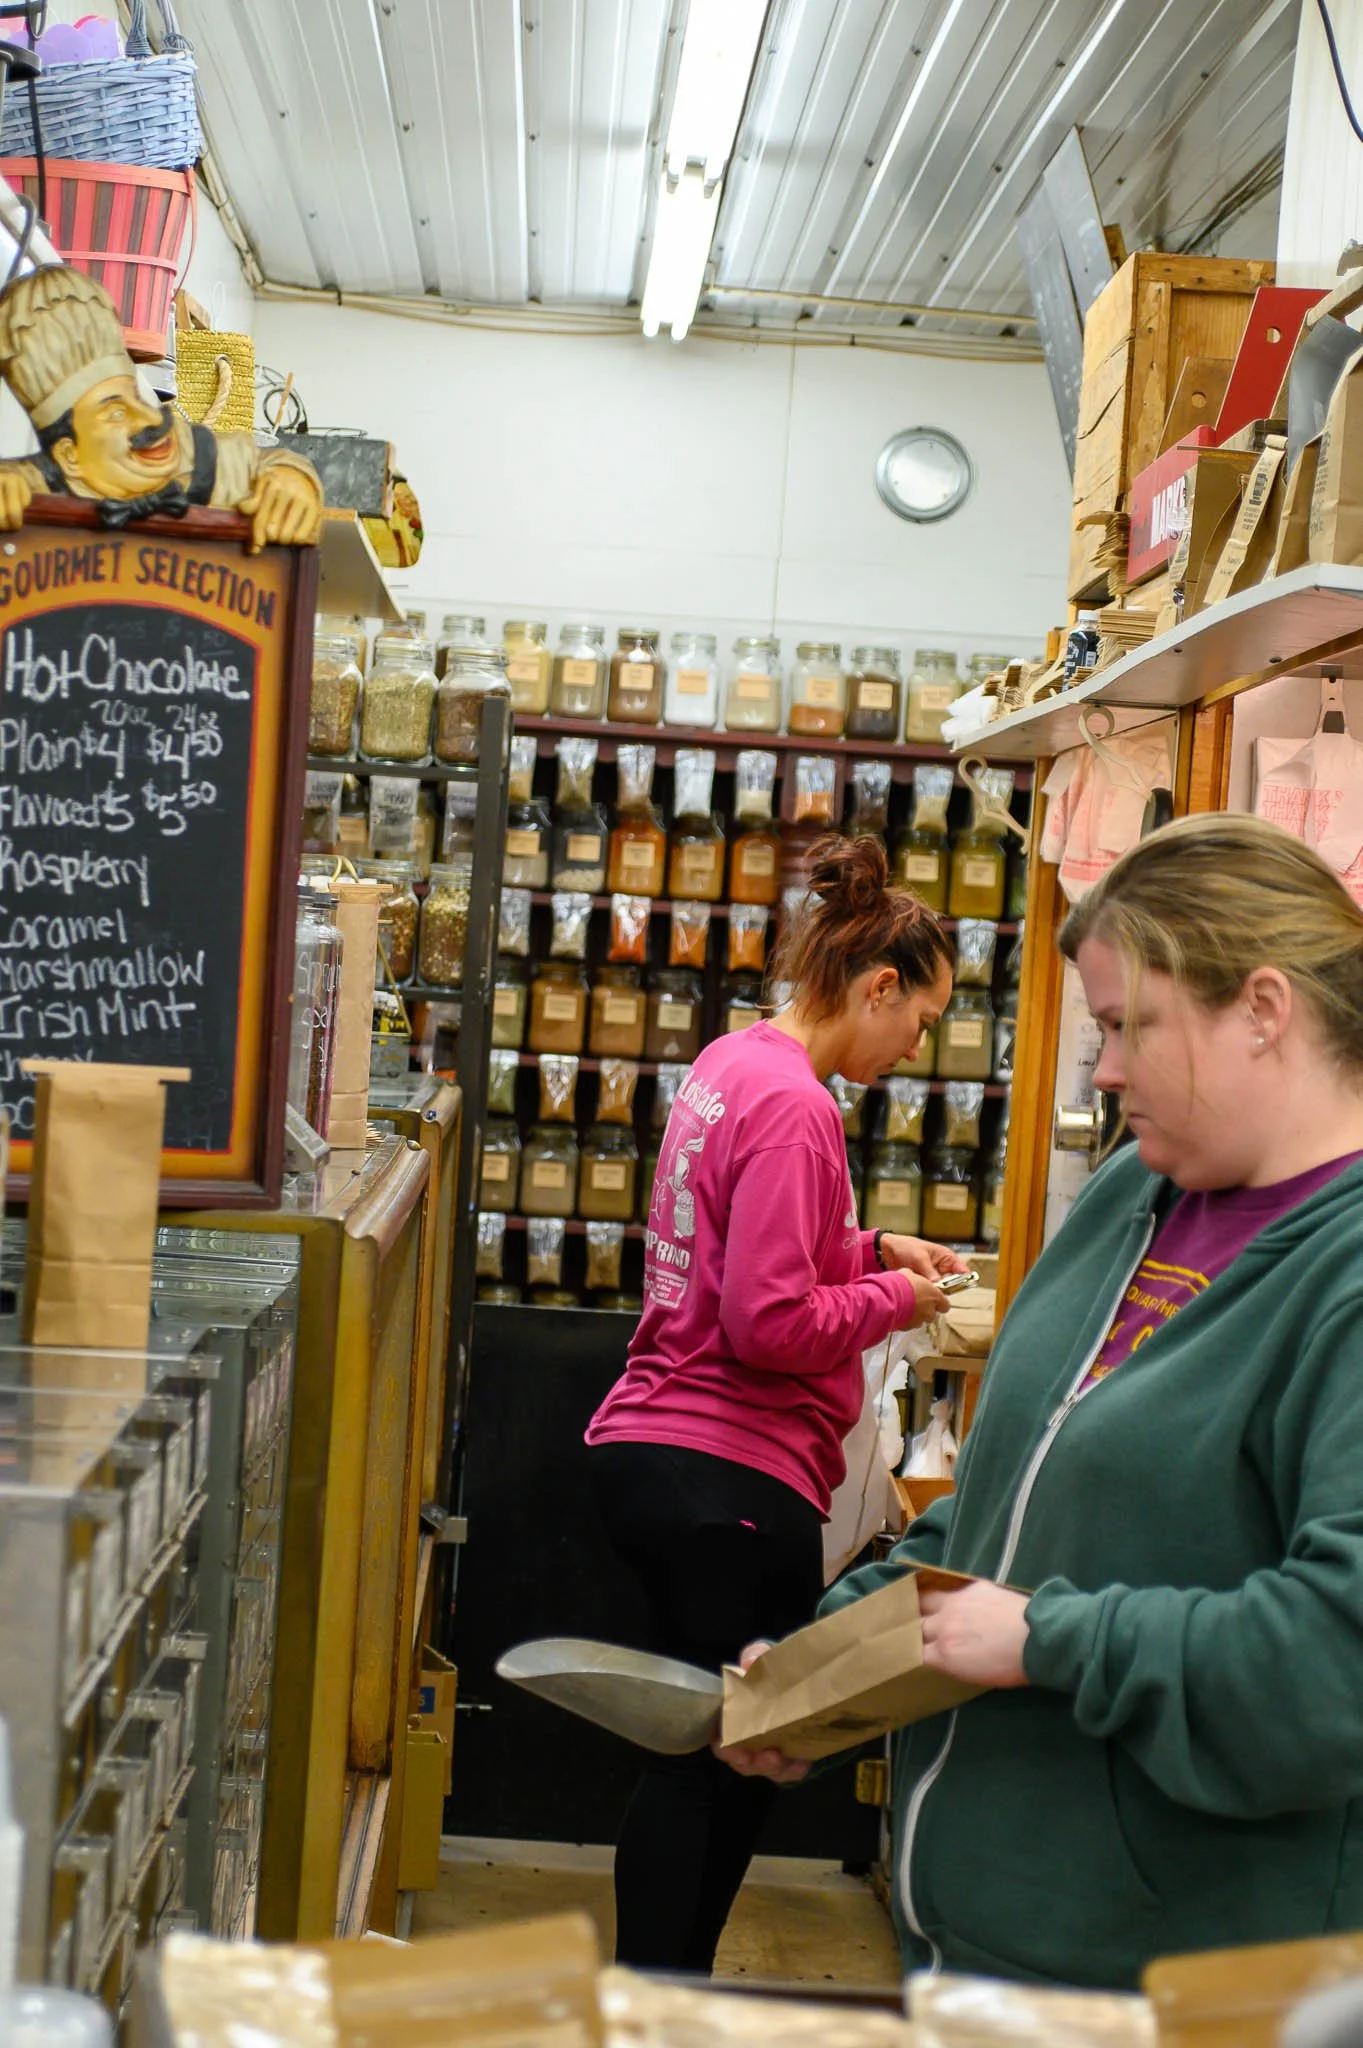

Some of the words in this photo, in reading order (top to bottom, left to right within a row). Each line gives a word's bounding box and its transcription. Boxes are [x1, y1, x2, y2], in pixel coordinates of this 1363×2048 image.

[0, 541, 124, 607] GOURMET
[136, 546, 277, 630] SELECTION
[5, 628, 82, 703] Hot
[79, 633, 251, 700] Chocolate
[0, 718, 83, 774] Plain
[0, 994, 91, 1039] Irish
[97, 990, 196, 1036] Mint
